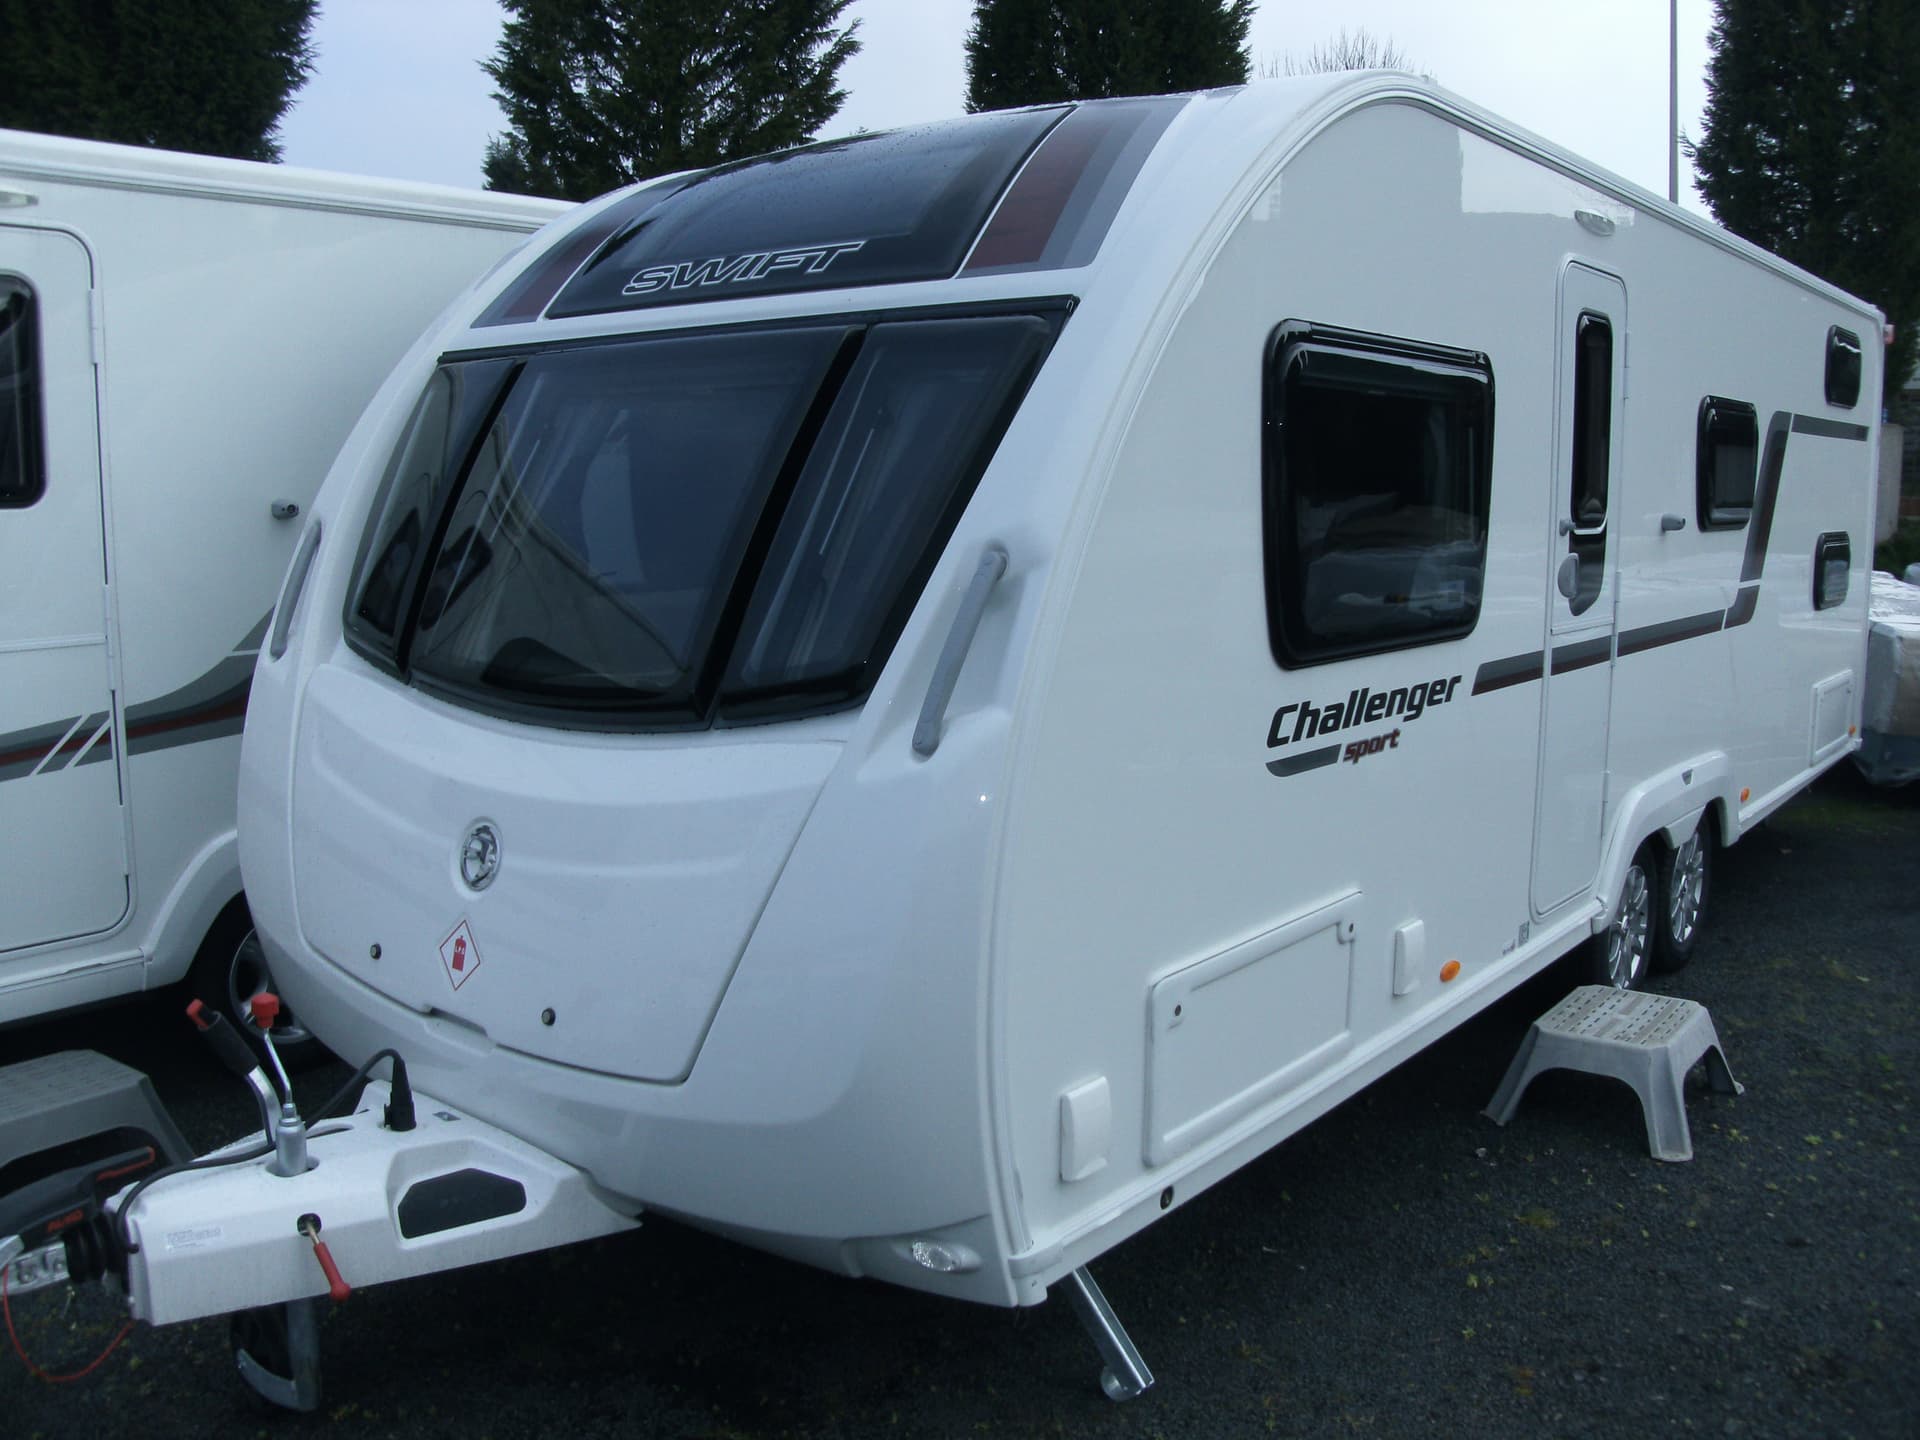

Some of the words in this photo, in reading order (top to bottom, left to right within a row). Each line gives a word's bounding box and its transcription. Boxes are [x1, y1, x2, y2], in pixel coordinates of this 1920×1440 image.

[622, 240, 867, 296] SWIFT
[1266, 674, 1463, 749] Challenger
[1342, 728, 1401, 765] sport
